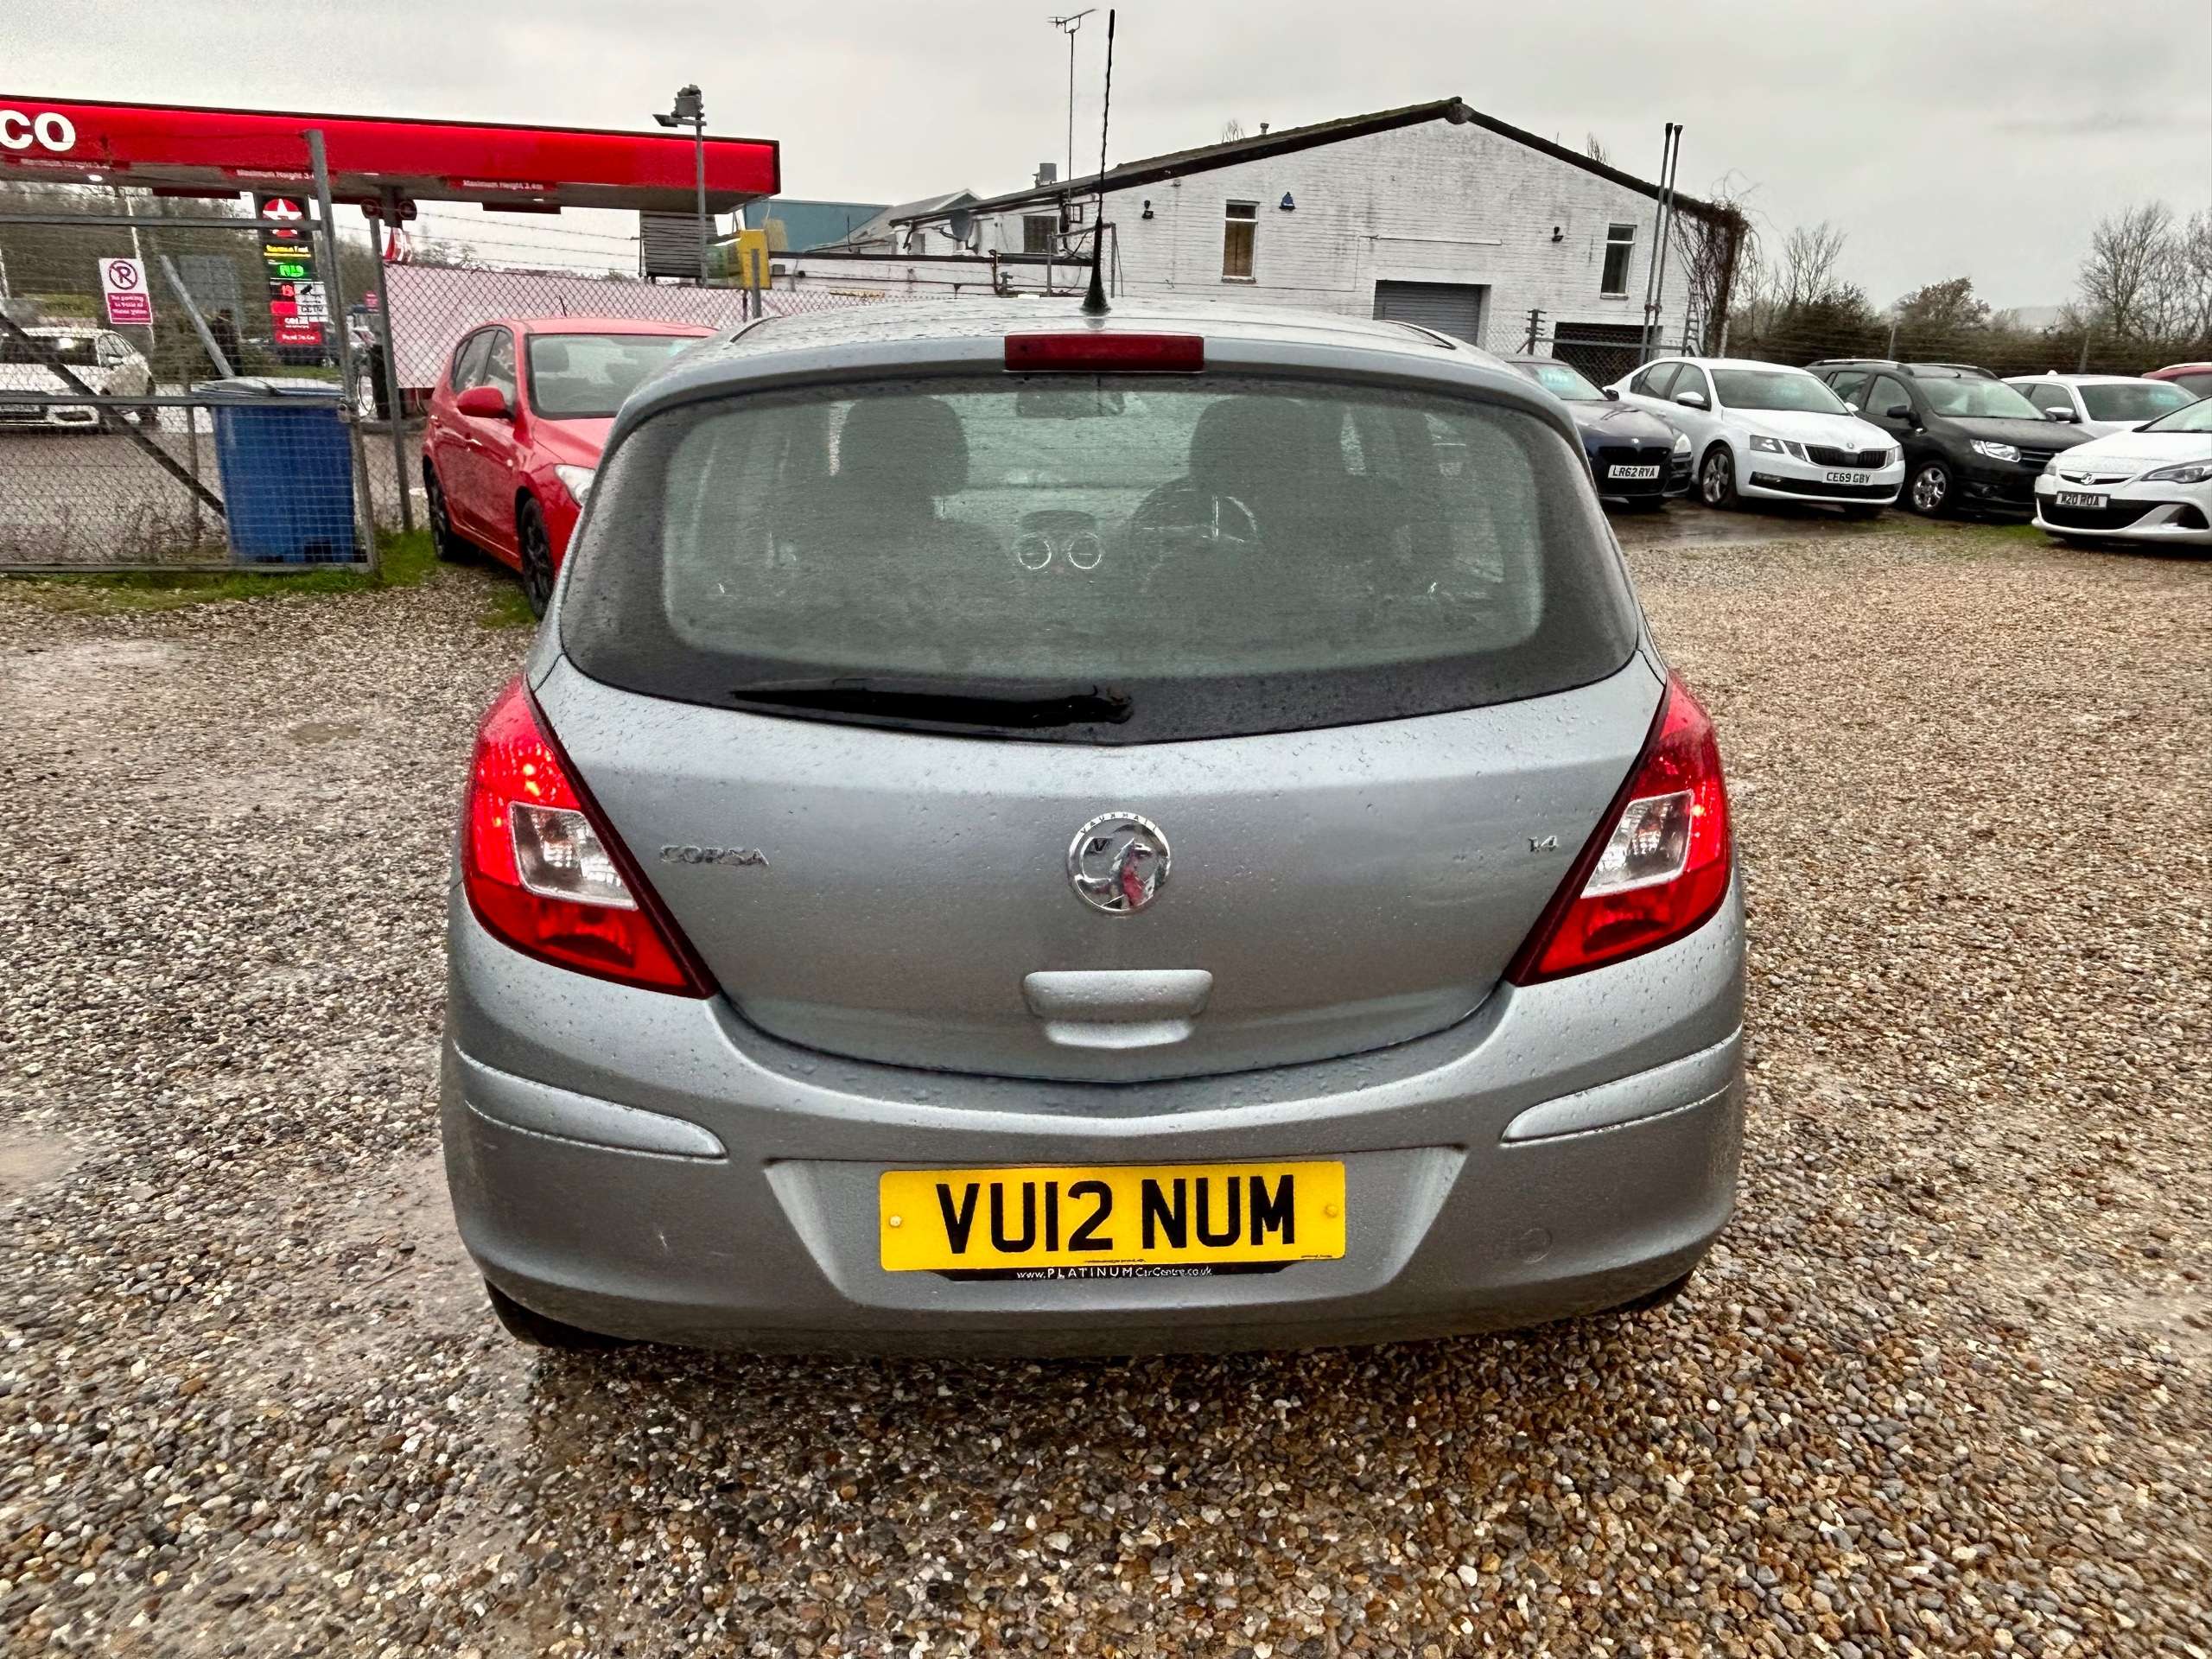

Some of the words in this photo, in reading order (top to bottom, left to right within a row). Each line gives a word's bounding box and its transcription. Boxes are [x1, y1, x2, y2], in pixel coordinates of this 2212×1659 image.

[1612, 466, 1638, 477] LR62
[1827, 472, 1851, 482] CE69
[660, 844, 769, 865] CORSA
[936, 1179, 1114, 1255] VU12
[1141, 1174, 1295, 1250] NUM
